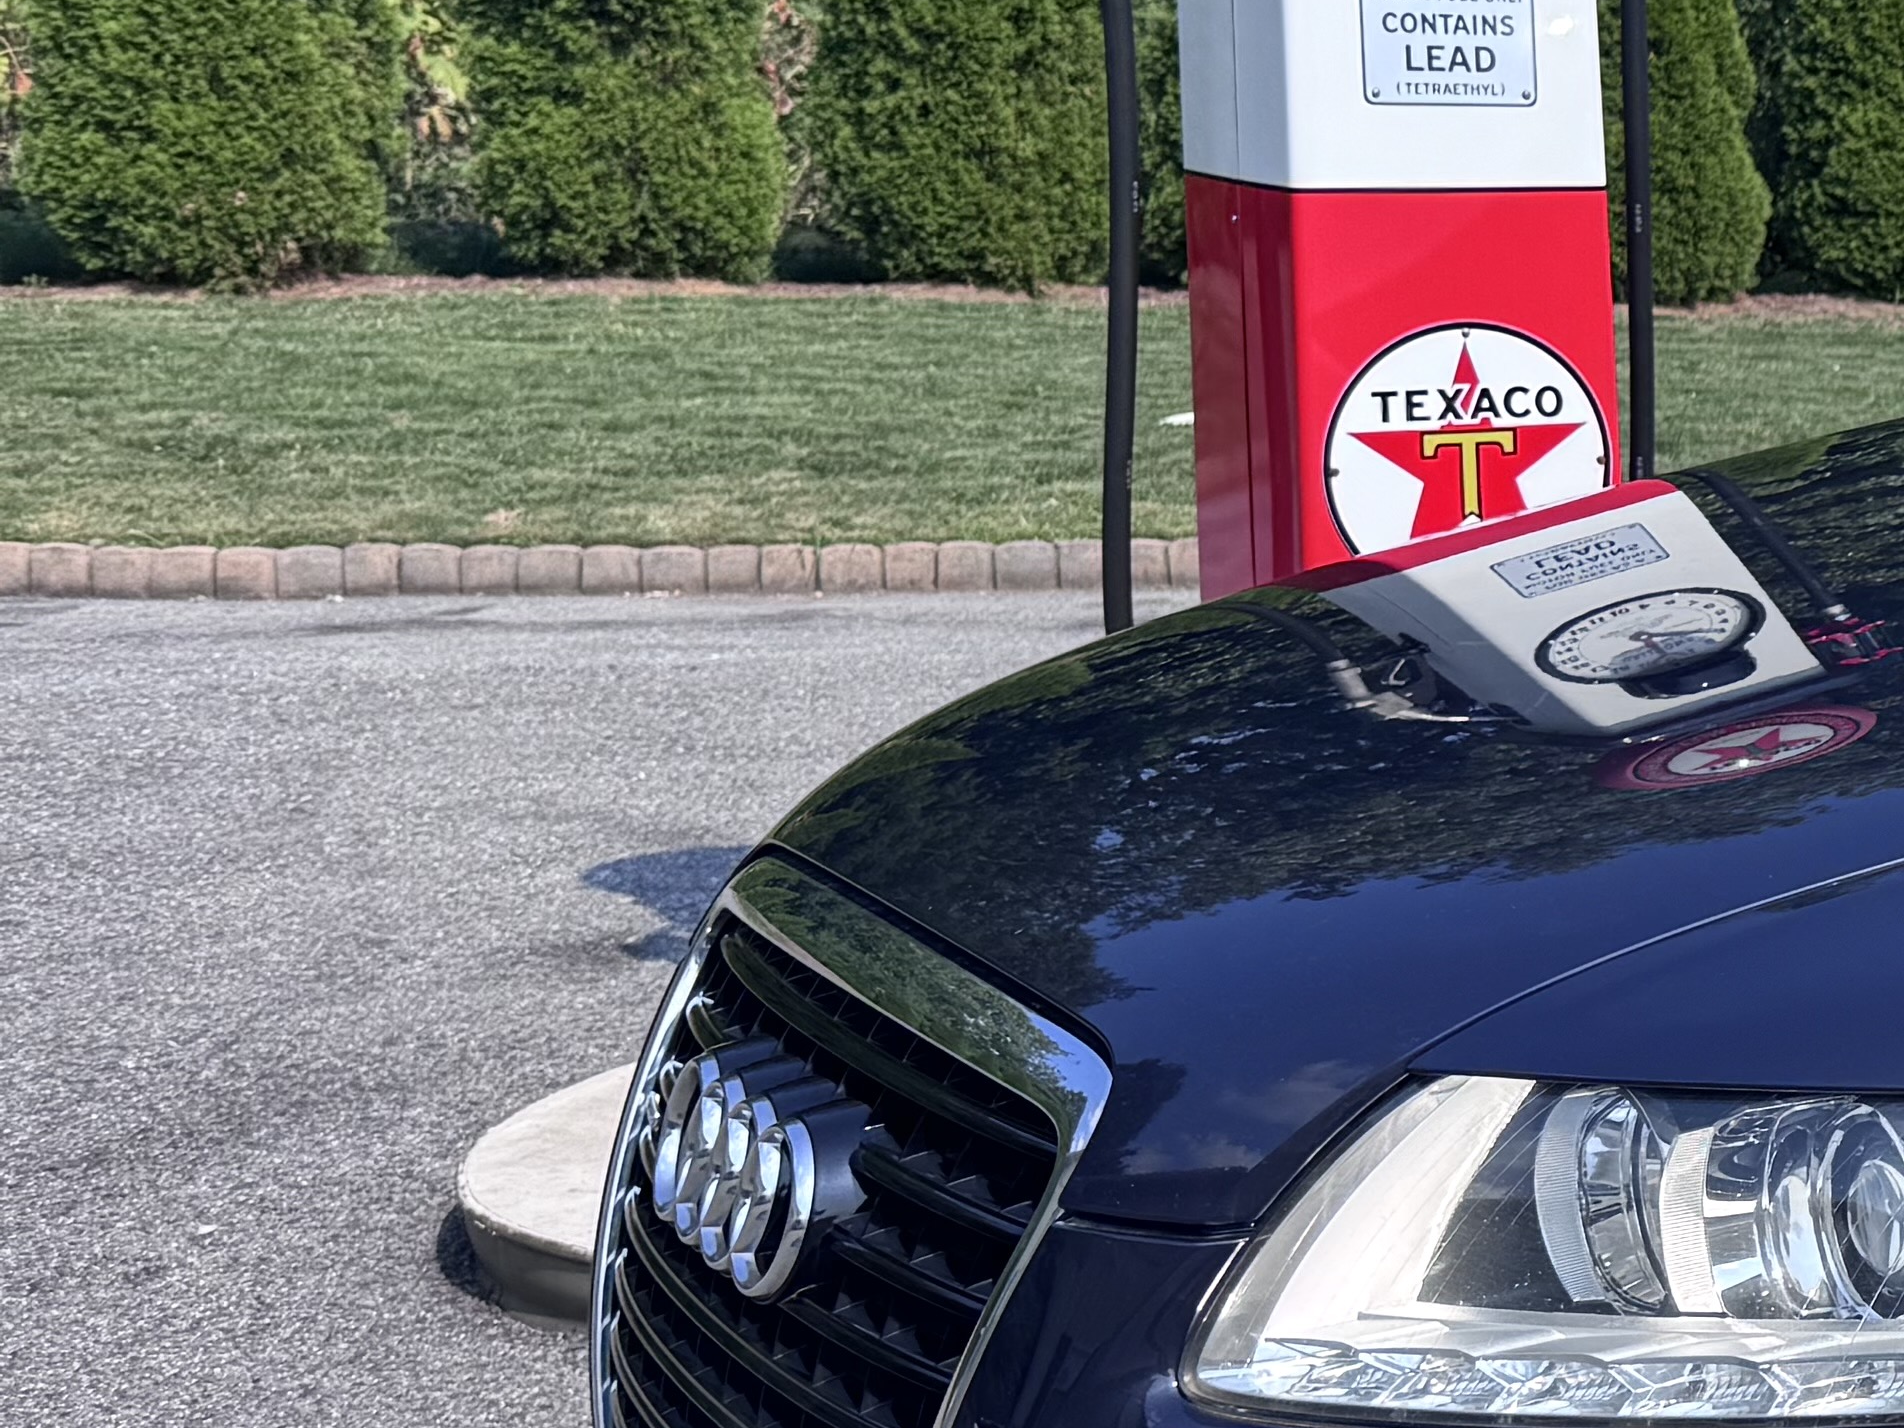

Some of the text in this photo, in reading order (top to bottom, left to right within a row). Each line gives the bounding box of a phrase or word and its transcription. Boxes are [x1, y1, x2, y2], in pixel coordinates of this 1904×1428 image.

[1382, 12, 1515, 36] CONTAINS
[1405, 44, 1497, 73] LEAD
[1371, 385, 1563, 422] TEXACO
